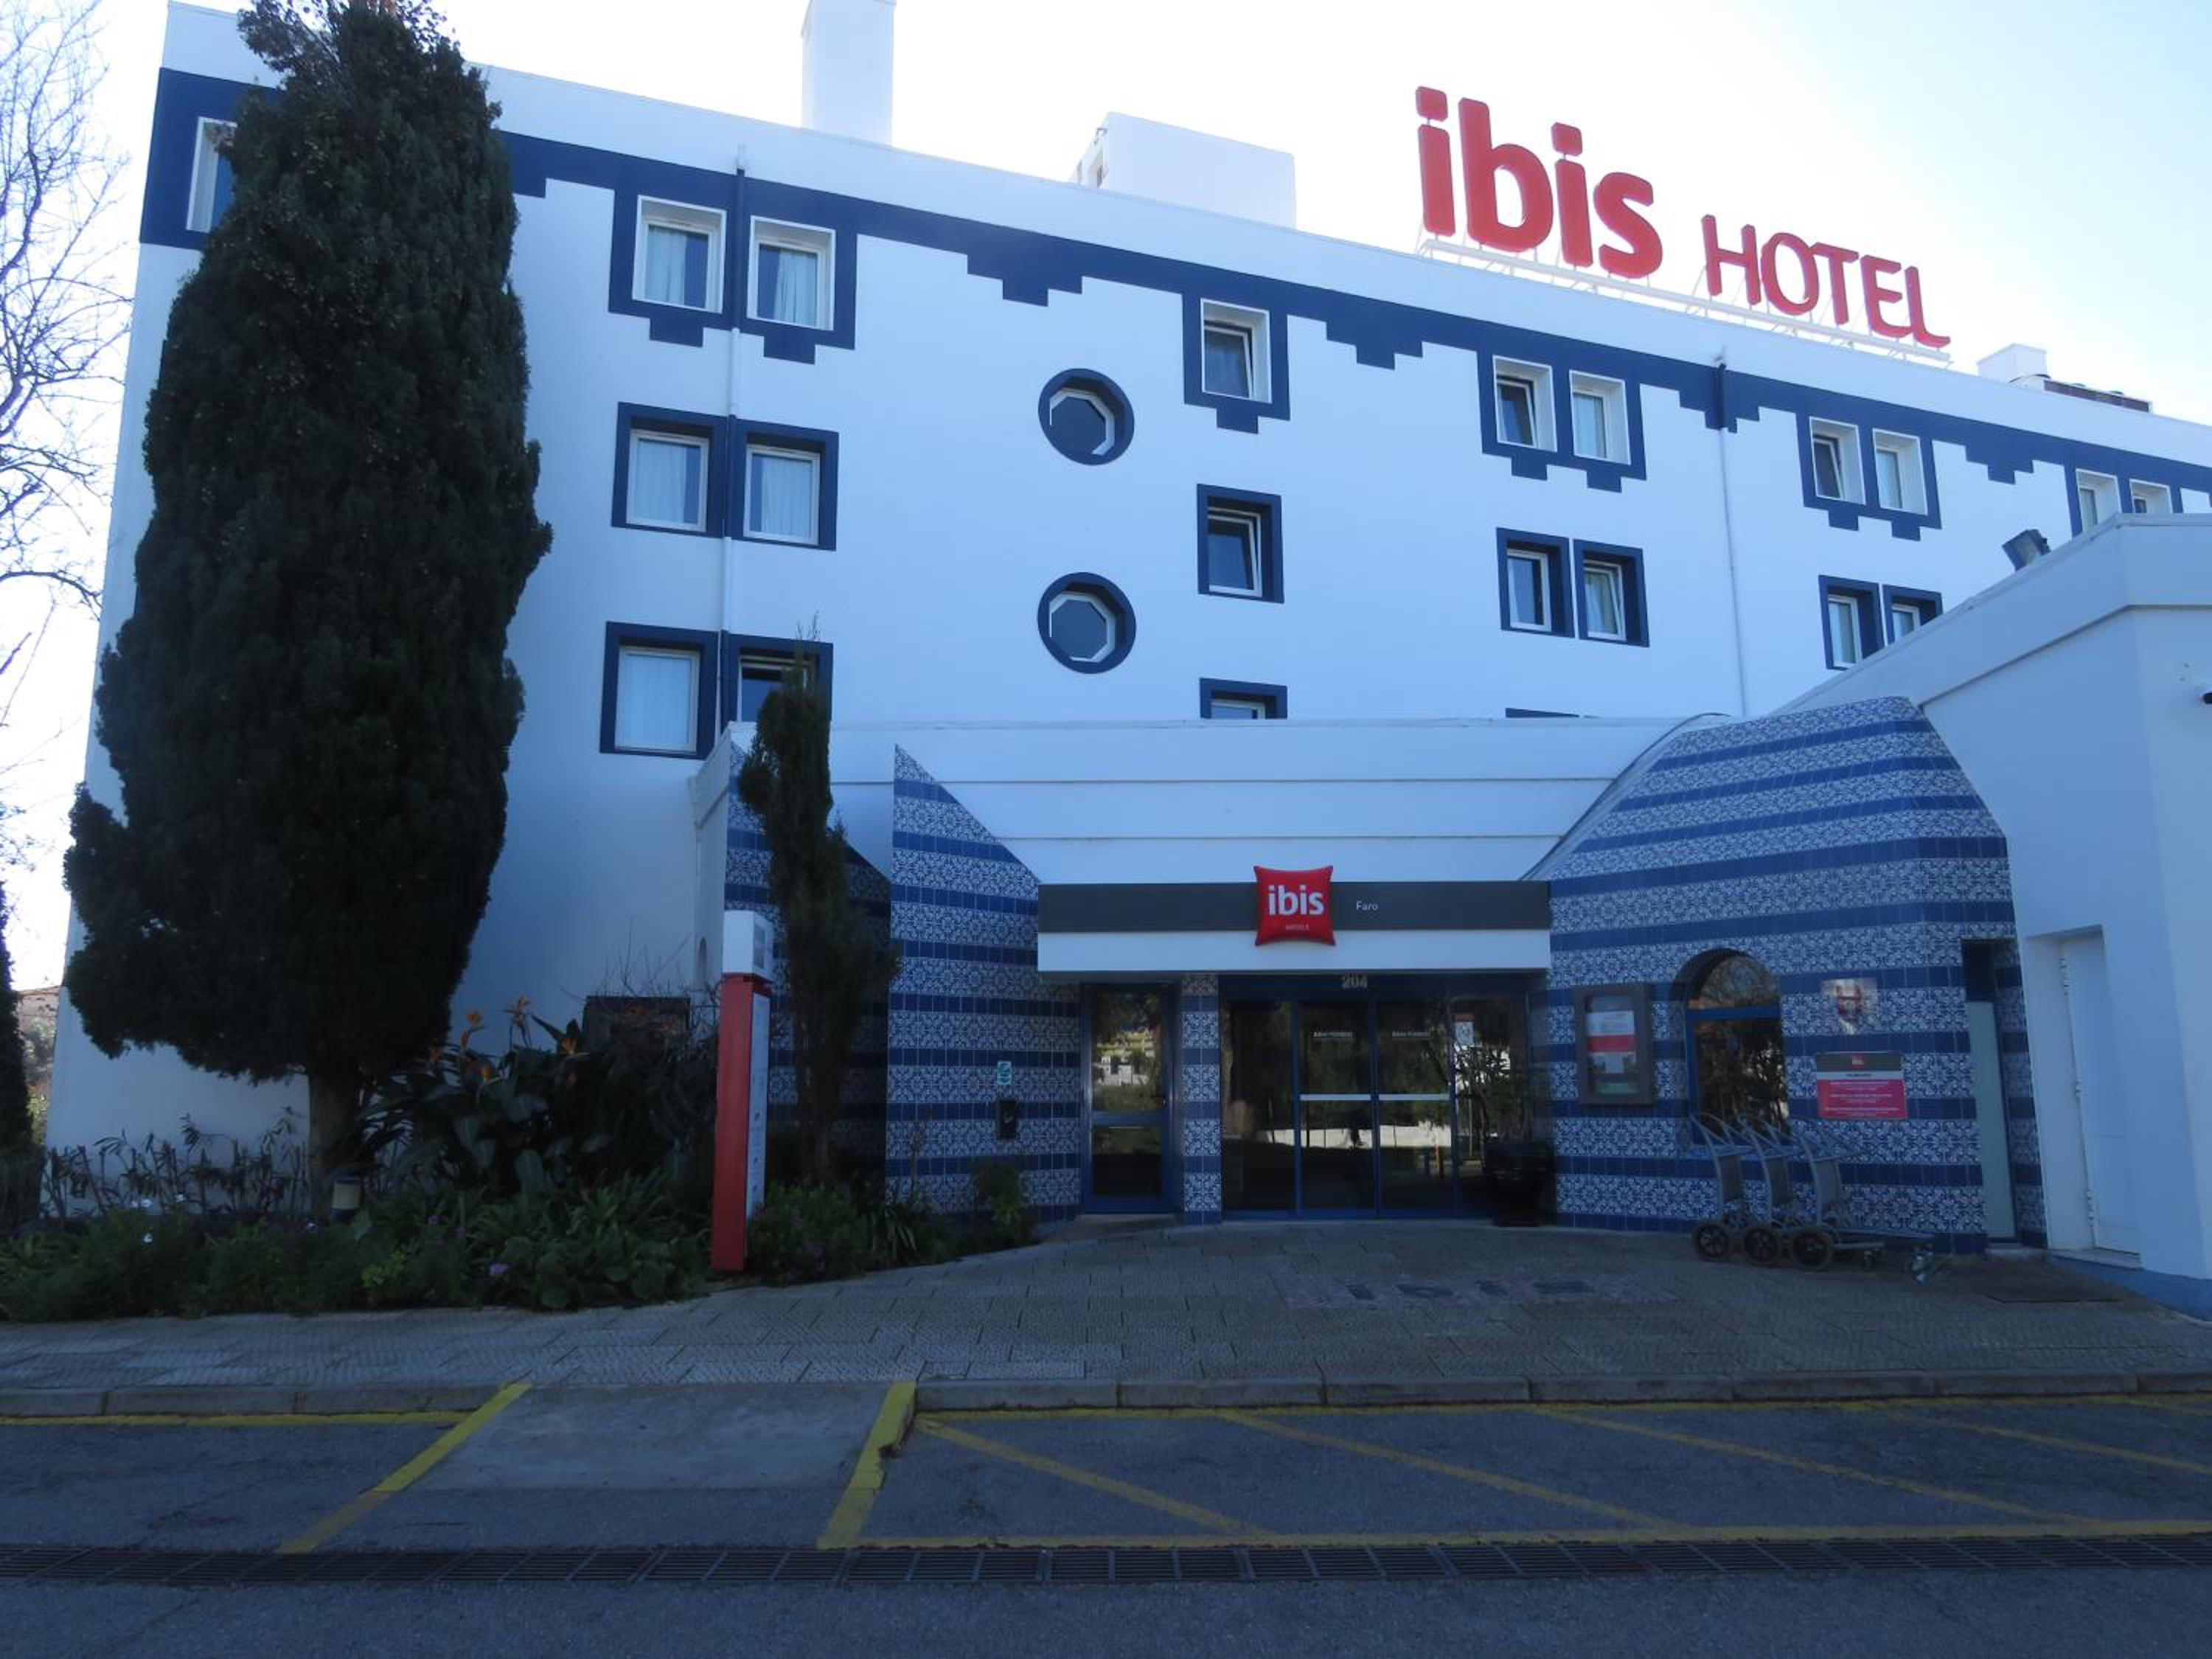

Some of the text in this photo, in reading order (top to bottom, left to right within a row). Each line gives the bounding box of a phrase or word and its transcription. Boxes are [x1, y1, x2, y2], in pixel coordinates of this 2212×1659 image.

[1416, 86, 1951, 348] ibis HOTEL
[1267, 884, 1325, 916] ibis
[1356, 900, 1379, 911] Faro
